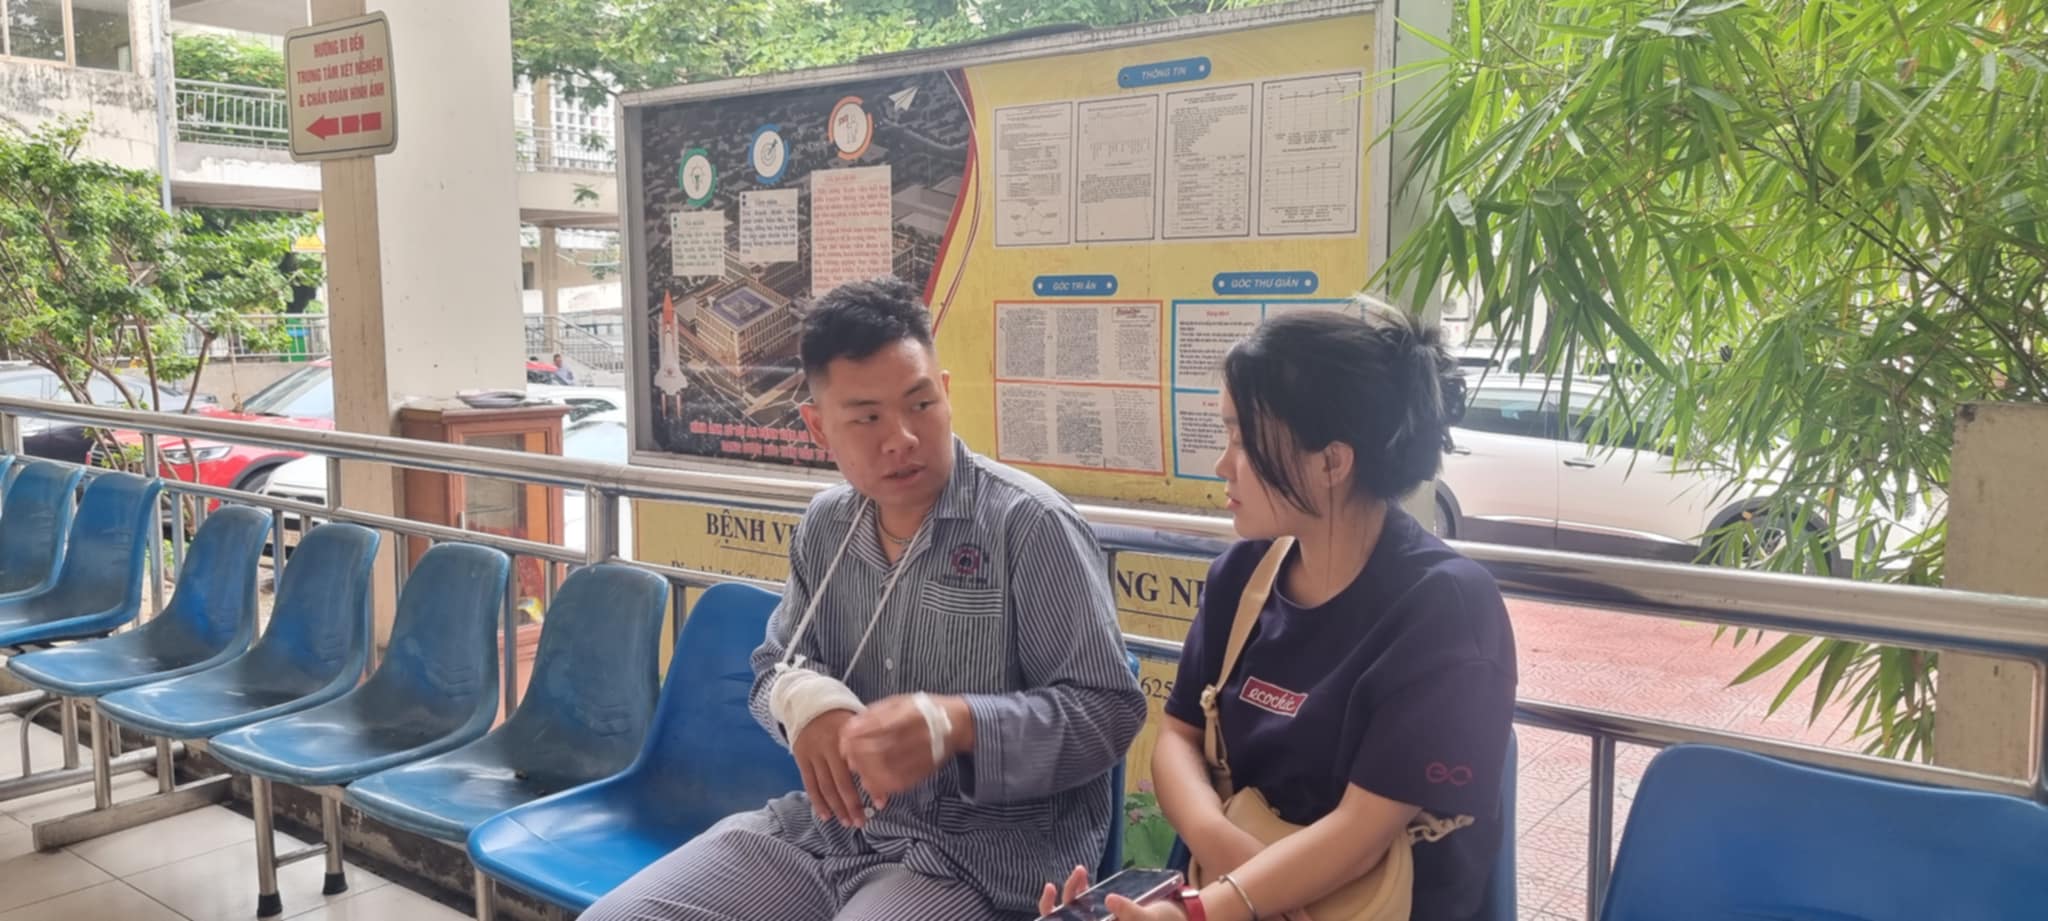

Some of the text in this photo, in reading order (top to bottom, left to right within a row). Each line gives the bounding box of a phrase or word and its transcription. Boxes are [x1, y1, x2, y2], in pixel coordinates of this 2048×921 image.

[340, 37, 348, 53] ĐI
[349, 32, 365, 52] ĐẾN
[297, 55, 384, 84] TRUNG TÂM XÉT NGHIỆM
[1142, 66, 1187, 81] THÔNG TIN
[299, 94, 305, 107] &
[328, 86, 349, 104] ĐOÁN
[349, 82, 369, 101] HÌNH
[1053, 280, 1071, 291] GÓC
[1231, 278, 1251, 289] GÓC
[1253, 277, 1274, 289] THƯ
[707, 509, 765, 544] BỆNH
[1249, 688, 1296, 711] ecochic
